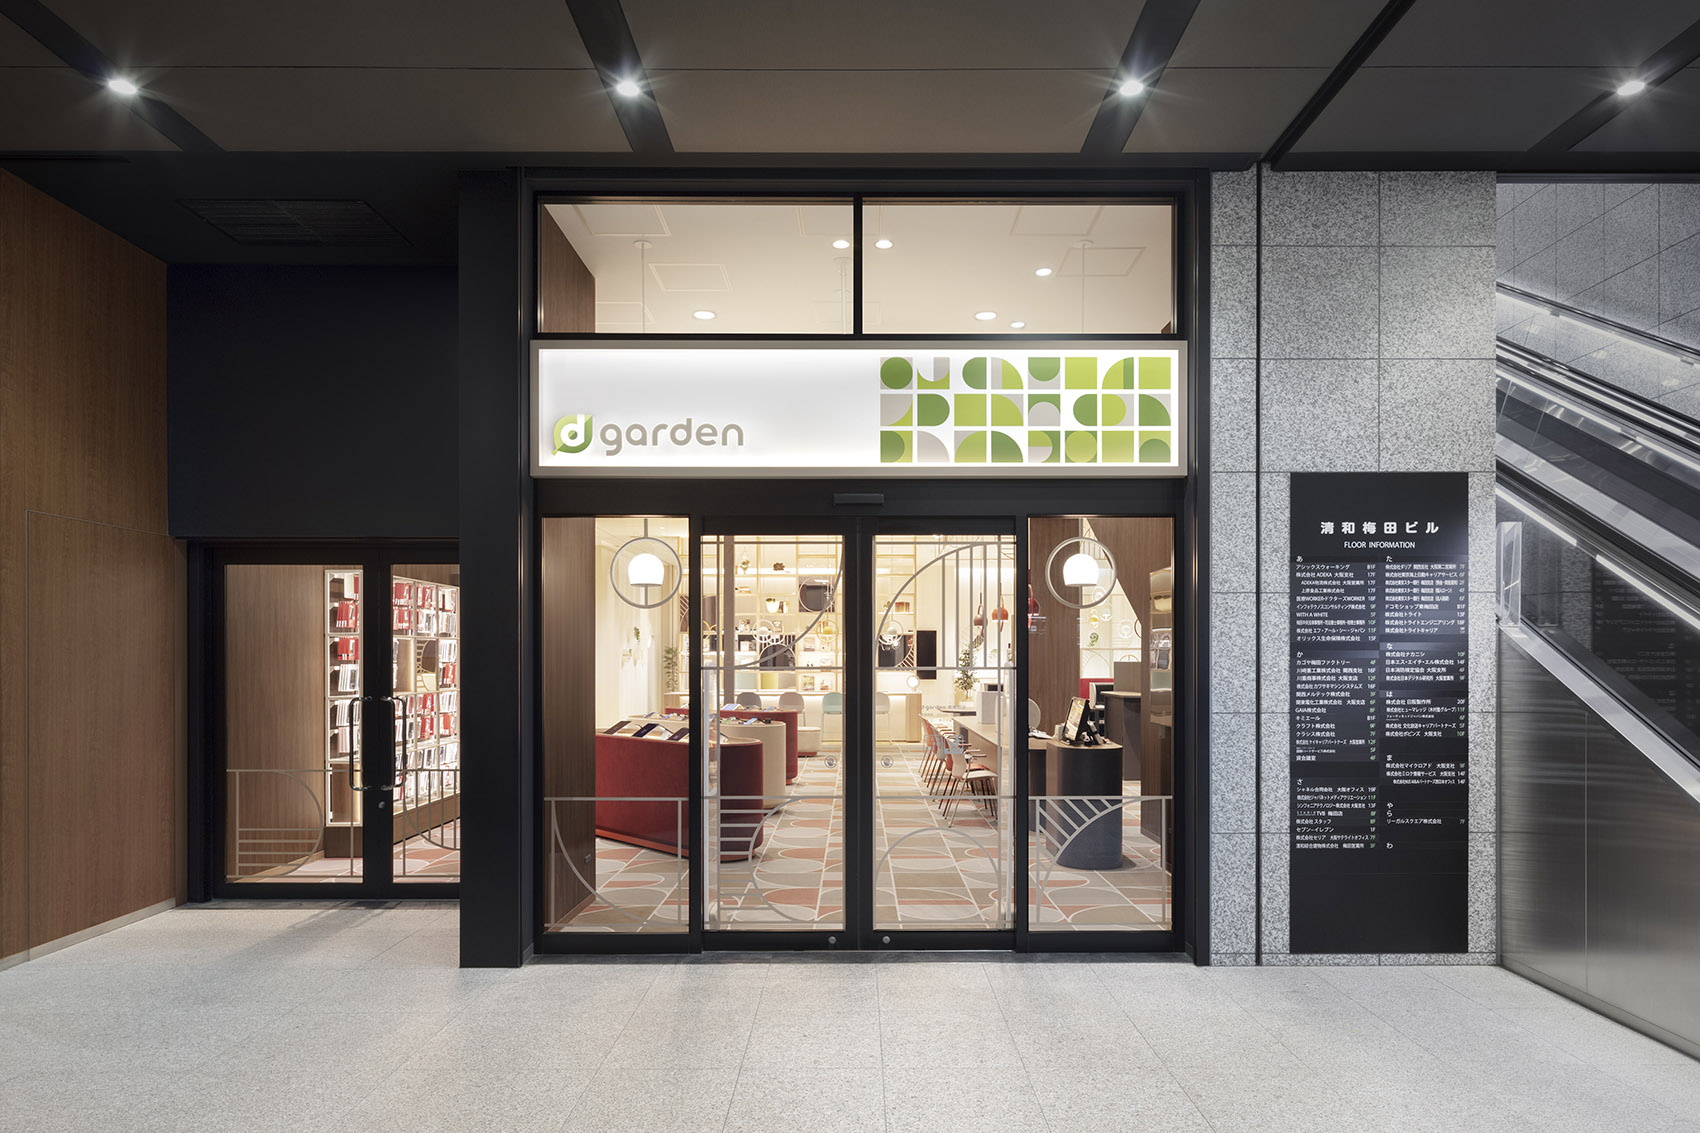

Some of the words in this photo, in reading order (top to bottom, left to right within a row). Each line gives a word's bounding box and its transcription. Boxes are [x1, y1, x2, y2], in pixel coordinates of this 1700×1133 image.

[600, 418, 744, 456] garden
[1320, 521, 1440, 535] 清和梅田ビル
[1344, 541, 1366, 549] FLOOR
[1369, 541, 1416, 549] INFORMATION
